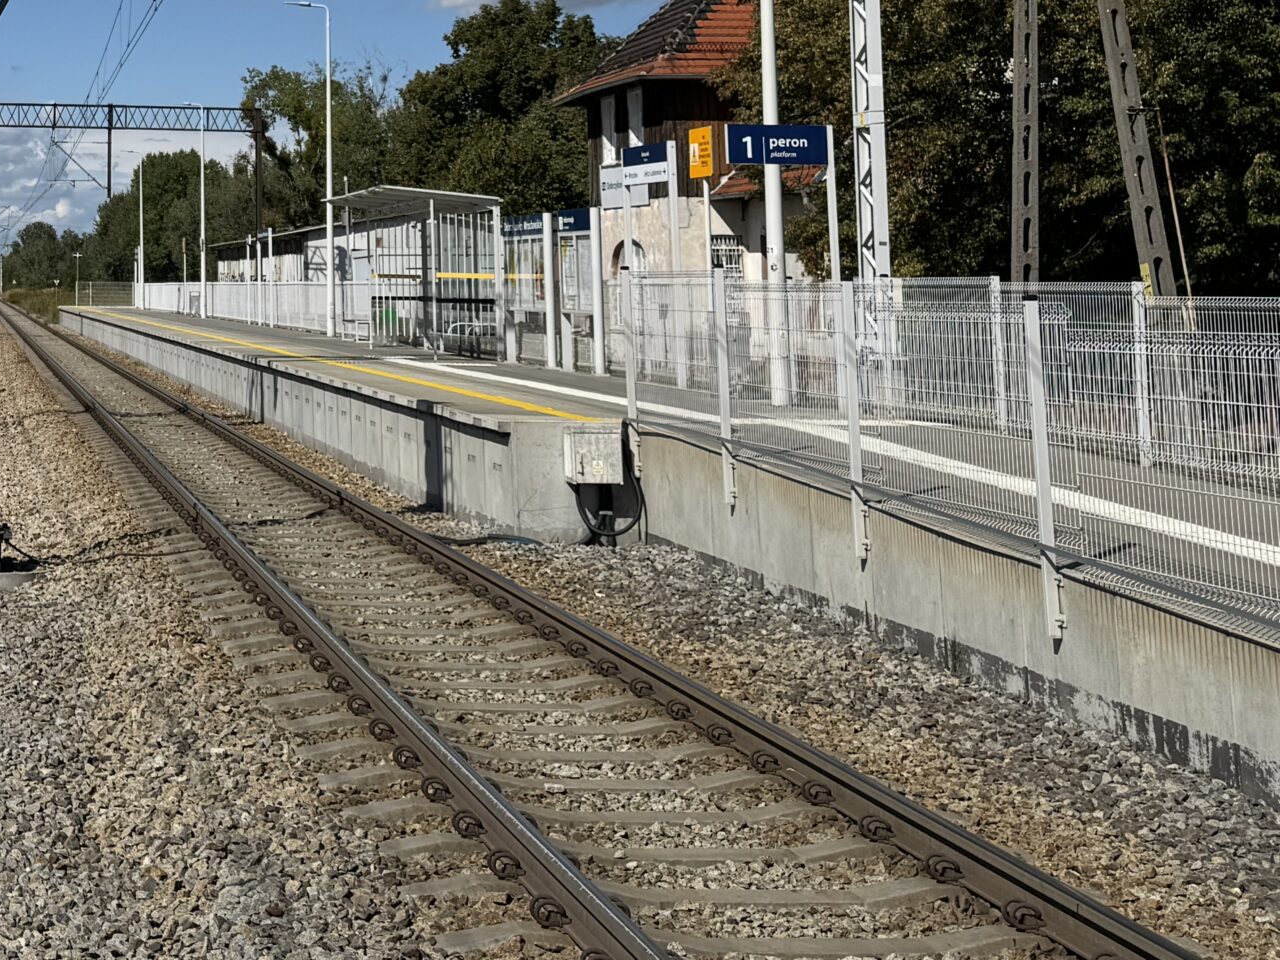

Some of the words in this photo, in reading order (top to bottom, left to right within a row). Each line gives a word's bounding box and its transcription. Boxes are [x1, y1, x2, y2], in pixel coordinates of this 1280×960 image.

[742, 135, 753, 159] 1
[769, 137, 809, 150] peron
[770, 151, 798, 159] platform
